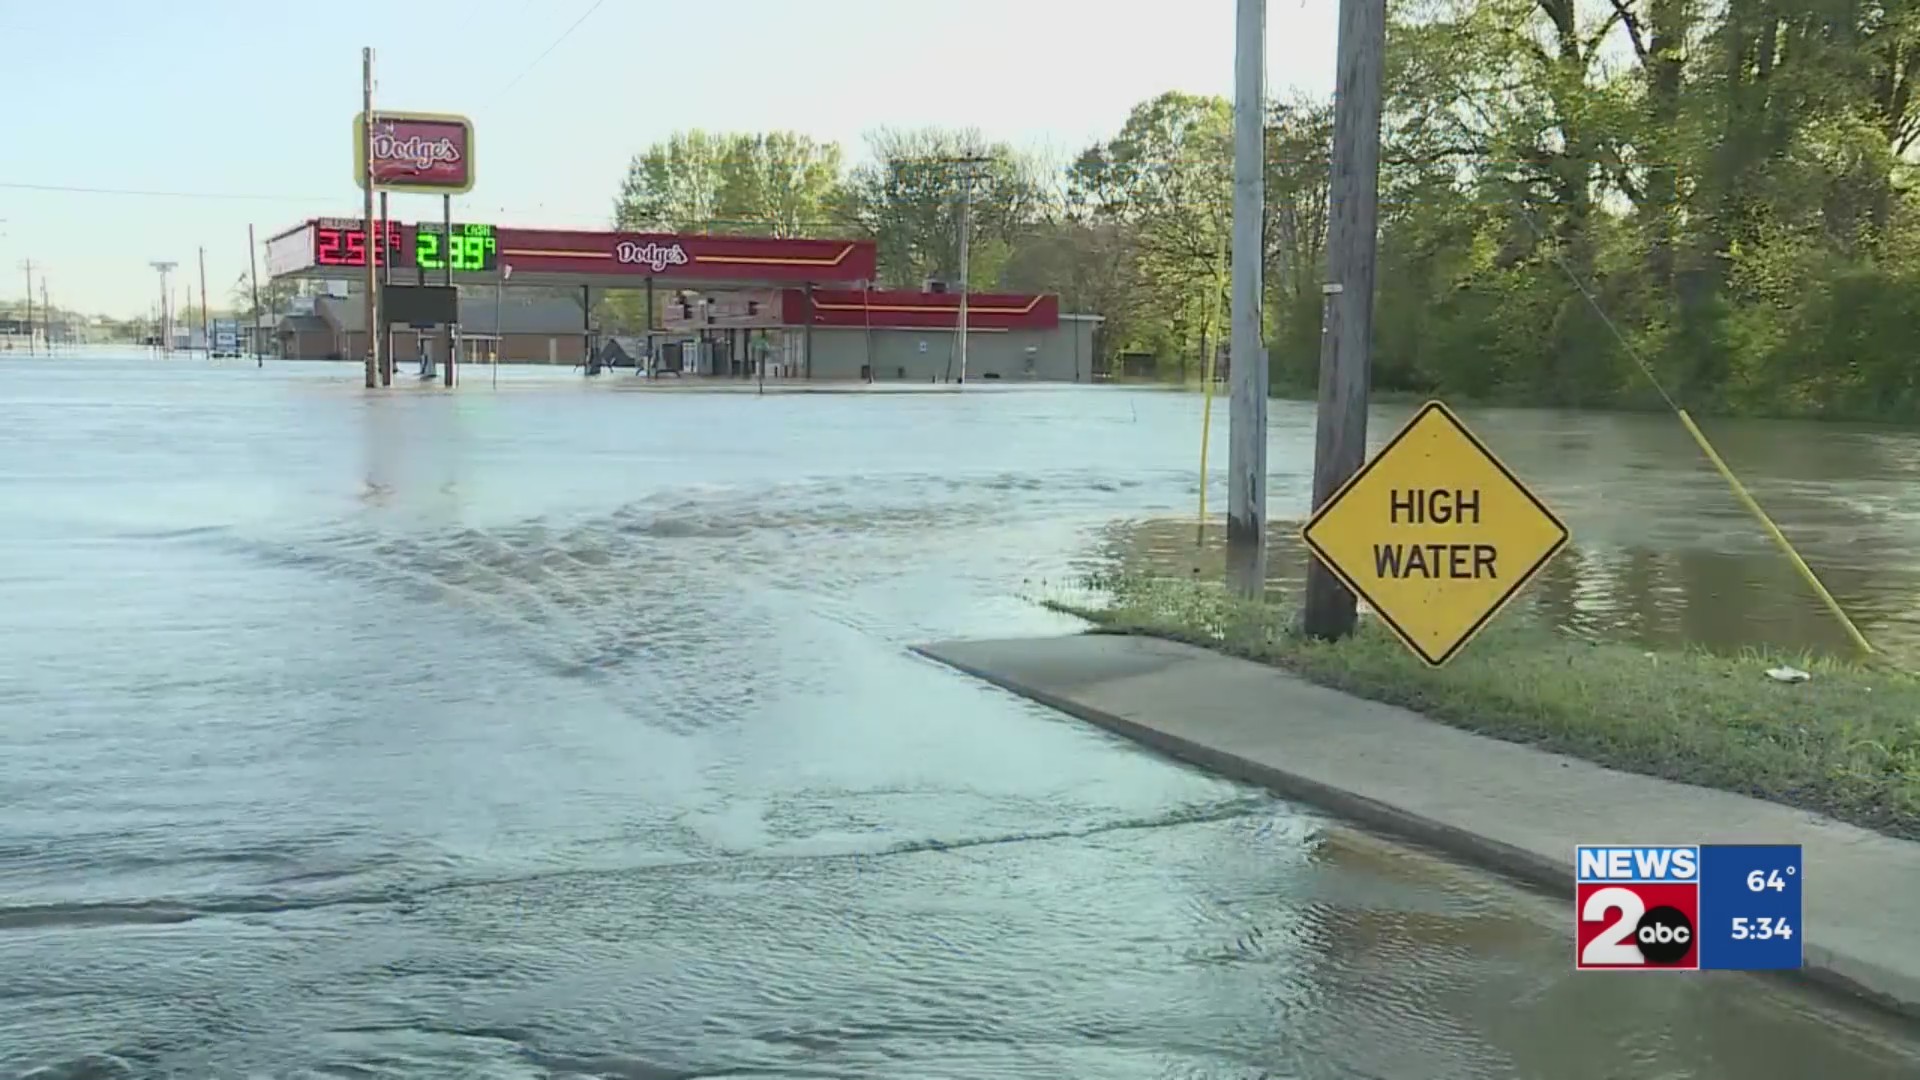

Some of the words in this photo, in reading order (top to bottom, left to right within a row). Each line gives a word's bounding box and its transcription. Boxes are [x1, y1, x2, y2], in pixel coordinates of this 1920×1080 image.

[374, 135, 460, 169] Dodge's
[616, 242, 688, 271] Dodge's
[1390, 489, 1480, 524] HIGH
[1373, 544, 1498, 579] WATER
